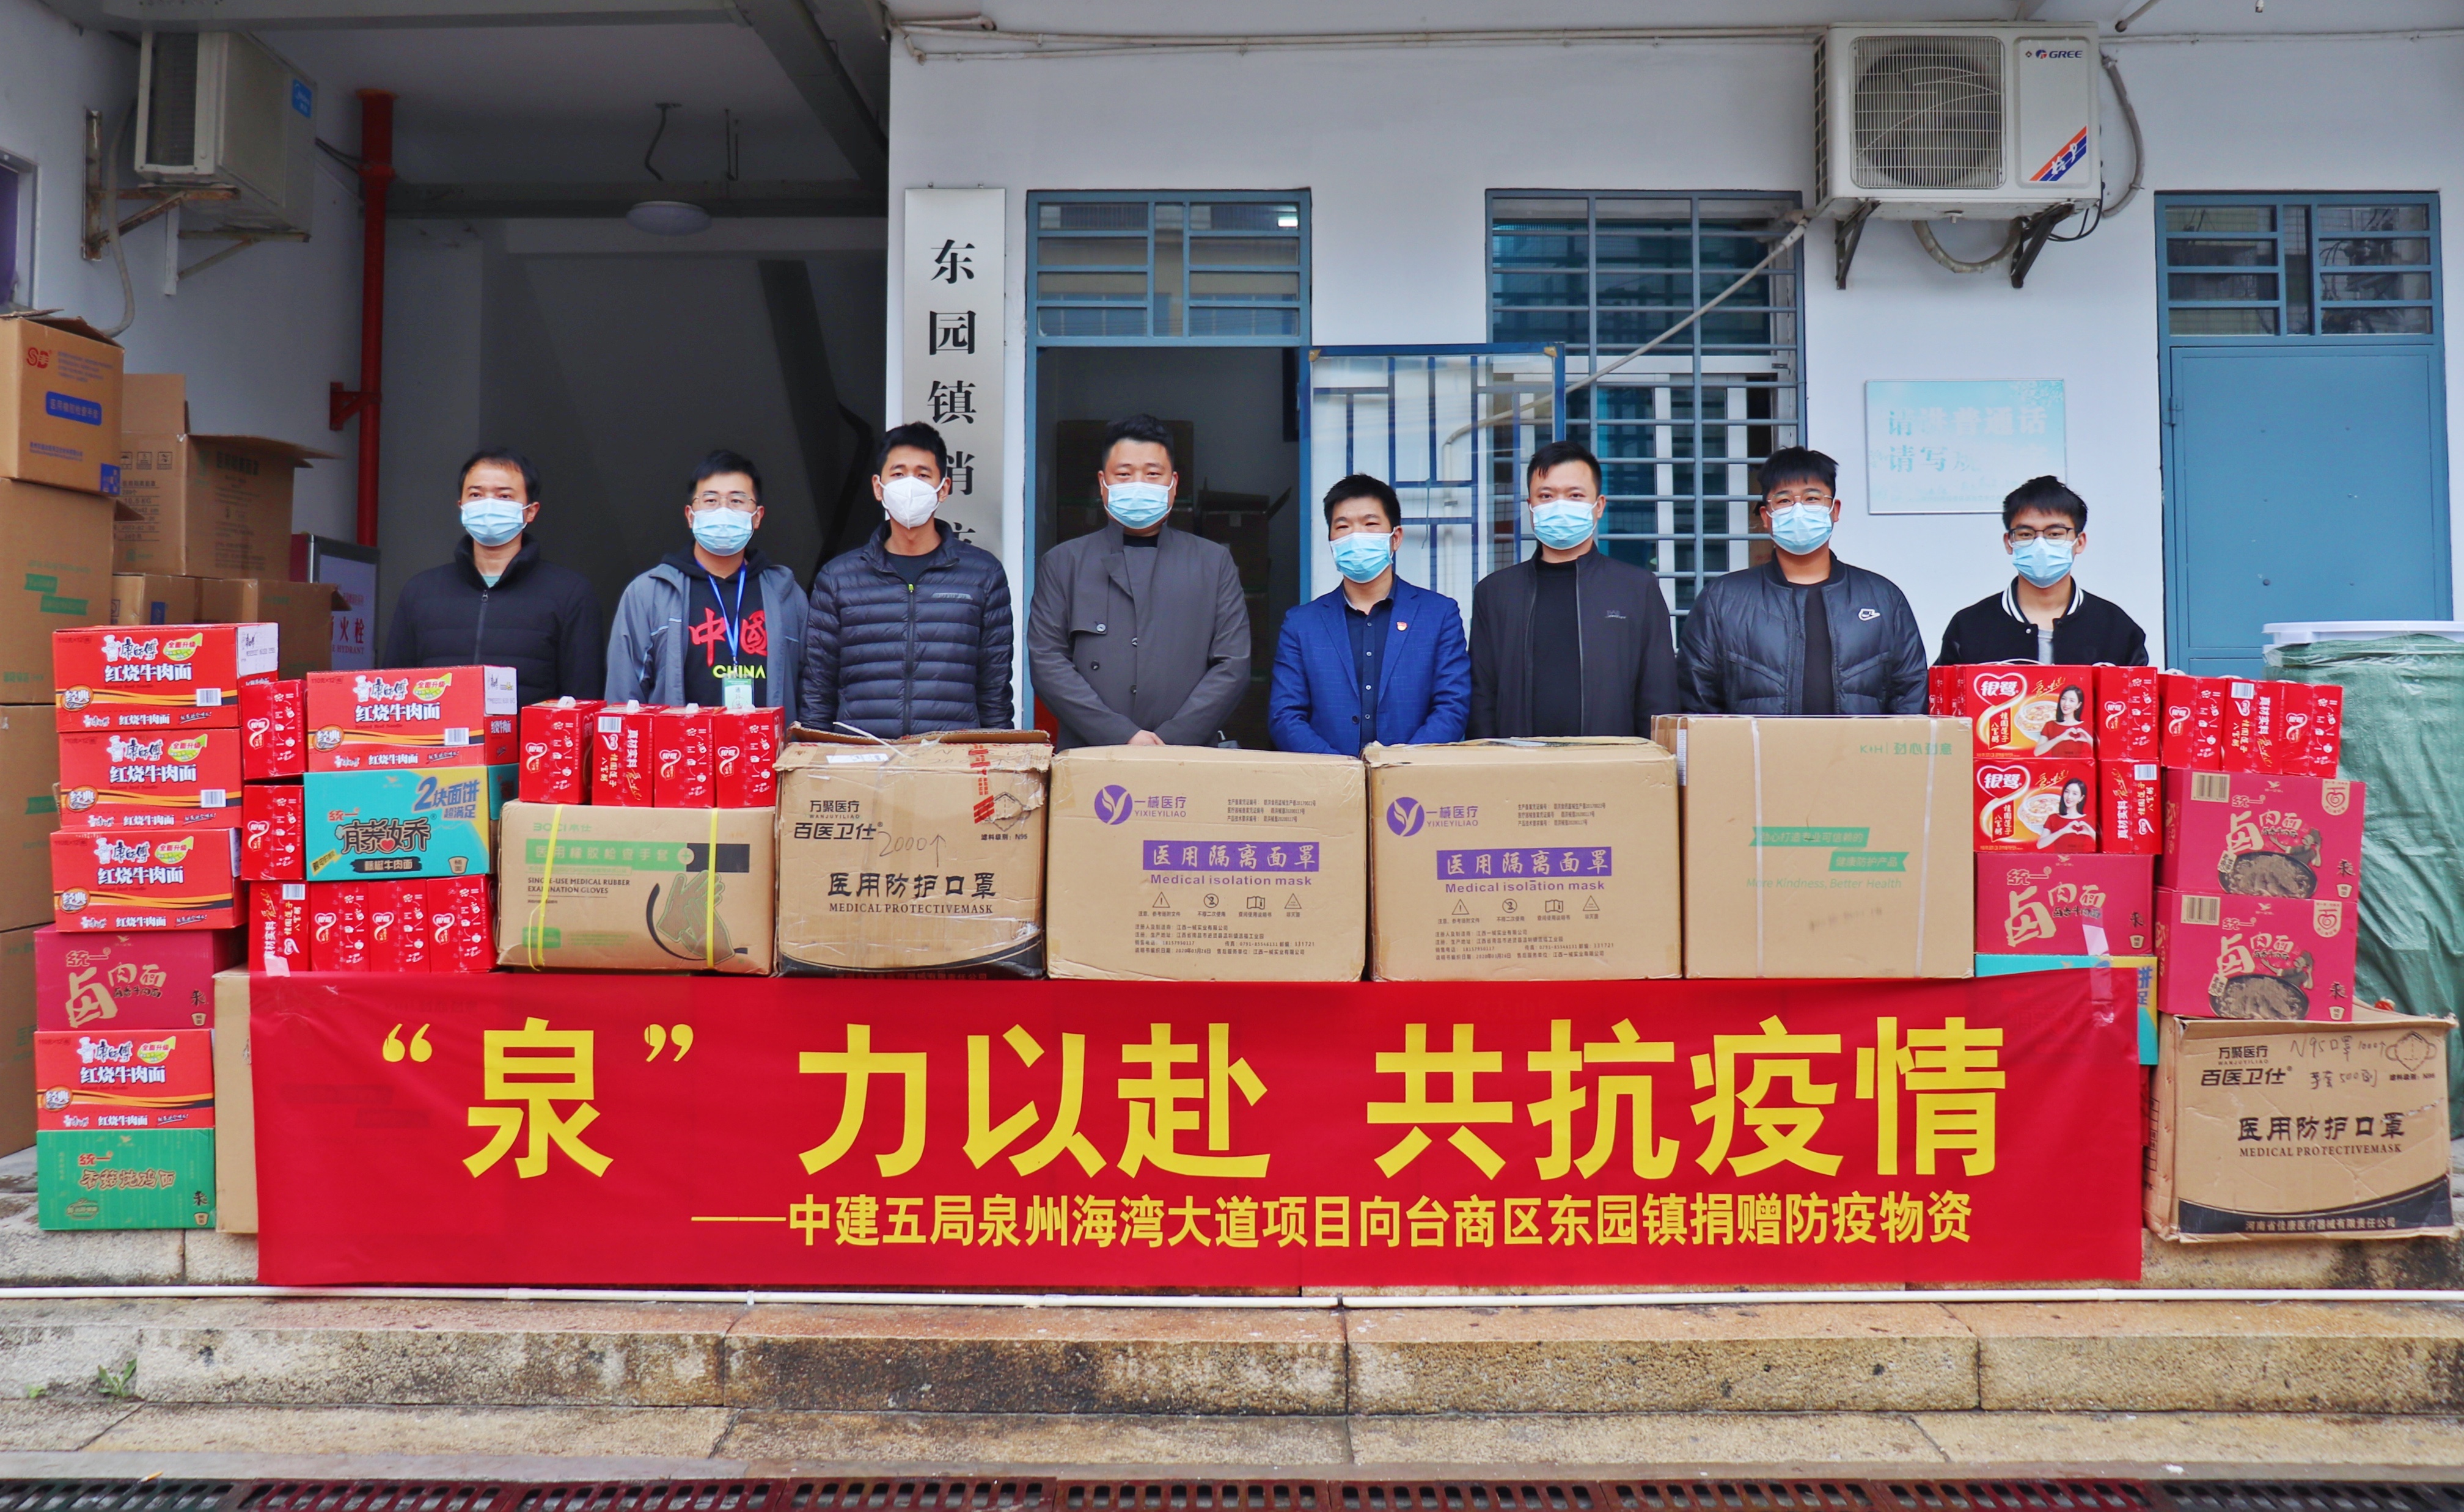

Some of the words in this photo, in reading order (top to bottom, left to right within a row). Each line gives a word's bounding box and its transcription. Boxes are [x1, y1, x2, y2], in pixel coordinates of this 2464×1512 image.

[331, 616, 365, 643] 火栓
[337, 645, 364, 654] HYDRANT
[105, 663, 193, 682] 红烧牛肉面
[713, 665, 766, 679] CHINA
[64, 690, 90, 703] 经典
[1980, 681, 2019, 697] 银鹭
[119, 714, 170, 725] 红烧牛肉面
[355, 703, 441, 723] 红烧牛肉面
[2257, 695, 2270, 735] 真材实料
[2000, 712, 2009, 743] 桂圆莲子
[317, 729, 342, 743] 经典
[626, 729, 639, 769] 真材实料
[368, 753, 419, 765] 红烧牛肉面
[109, 764, 197, 783] 红烧牛肉面
[1984, 773, 2022, 789] 银鹭
[69, 791, 95, 804] 经典
[413, 776, 480, 812] 2块面饼
[1134, 795, 1187, 809] 一械医疗
[2231, 794, 2264, 808] 统一
[444, 805, 476, 819] 超满足
[809, 800, 860, 813] 万聚医疗
[1426, 806, 1479, 819] 一械医疗
[123, 814, 175, 827] 红烧牛肉面
[328, 810, 359, 822] 统一
[2003, 805, 2012, 835] 桂圆莲子
[2117, 800, 2128, 839] 真材实料
[794, 822, 876, 840] 百医卫仕
[1994, 814, 2003, 835] 八宝粥
[2226, 809, 2303, 854] 卤肉面
[160, 843, 188, 852] 全面升级
[535, 845, 669, 862] 医用橡胶检查手套
[365, 859, 413, 871] 藤椒牛肉面
[1153, 844, 1317, 870] 医用隔离面罩
[1447, 849, 1609, 875] 医用隔离面罩
[1835, 856, 1898, 867] 健康防护产品
[97, 866, 184, 885] 红烧牛肉面
[1150, 874, 1205, 886] Medical
[1209, 874, 1272, 886] isolation
[1275, 876, 1312, 886] mask
[1746, 878, 1773, 888] More
[1777, 878, 1827, 889] Kindness,
[1830, 878, 1863, 887] Better
[1867, 878, 1902, 888] Health
[2007, 869, 2050, 886] 统一
[827, 872, 997, 900] 医用防护口罩
[1445, 883, 1499, 894] Medical
[1503, 881, 1565, 891] isolation
[1568, 880, 1605, 891] mask
[62, 892, 87, 905] 经典
[829, 903, 882, 913] MEDICAL
[884, 904, 994, 915] PROTECTIVEMASK
[2004, 882, 2106, 948] 卤肉面
[116, 916, 167, 928] 红烧牛肉面
[2221, 917, 2255, 930] 统一
[66, 950, 109, 967] 统一
[2216, 931, 2295, 977] 卤肉面
[65, 962, 167, 1029] 卤肉面
[2218, 1045, 2268, 1060] 万聚医疗
[79, 1065, 166, 1084] 红烧牛肉面
[2201, 1068, 2286, 1086] 百医卫仕
[45, 1090, 70, 1103] 经典
[1366, 1014, 2006, 1180] 共抗疫情
[98, 1114, 148, 1127] 红烧牛肉面
[2237, 1112, 2405, 1142] 医用防护口罩
[2239, 1145, 2294, 1157] MEDICAL
[2296, 1143, 2402, 1157] PROTECTIVEMASK
[78, 1153, 111, 1166] 统一
[79, 1169, 176, 1189] 香菇炖鸡面
